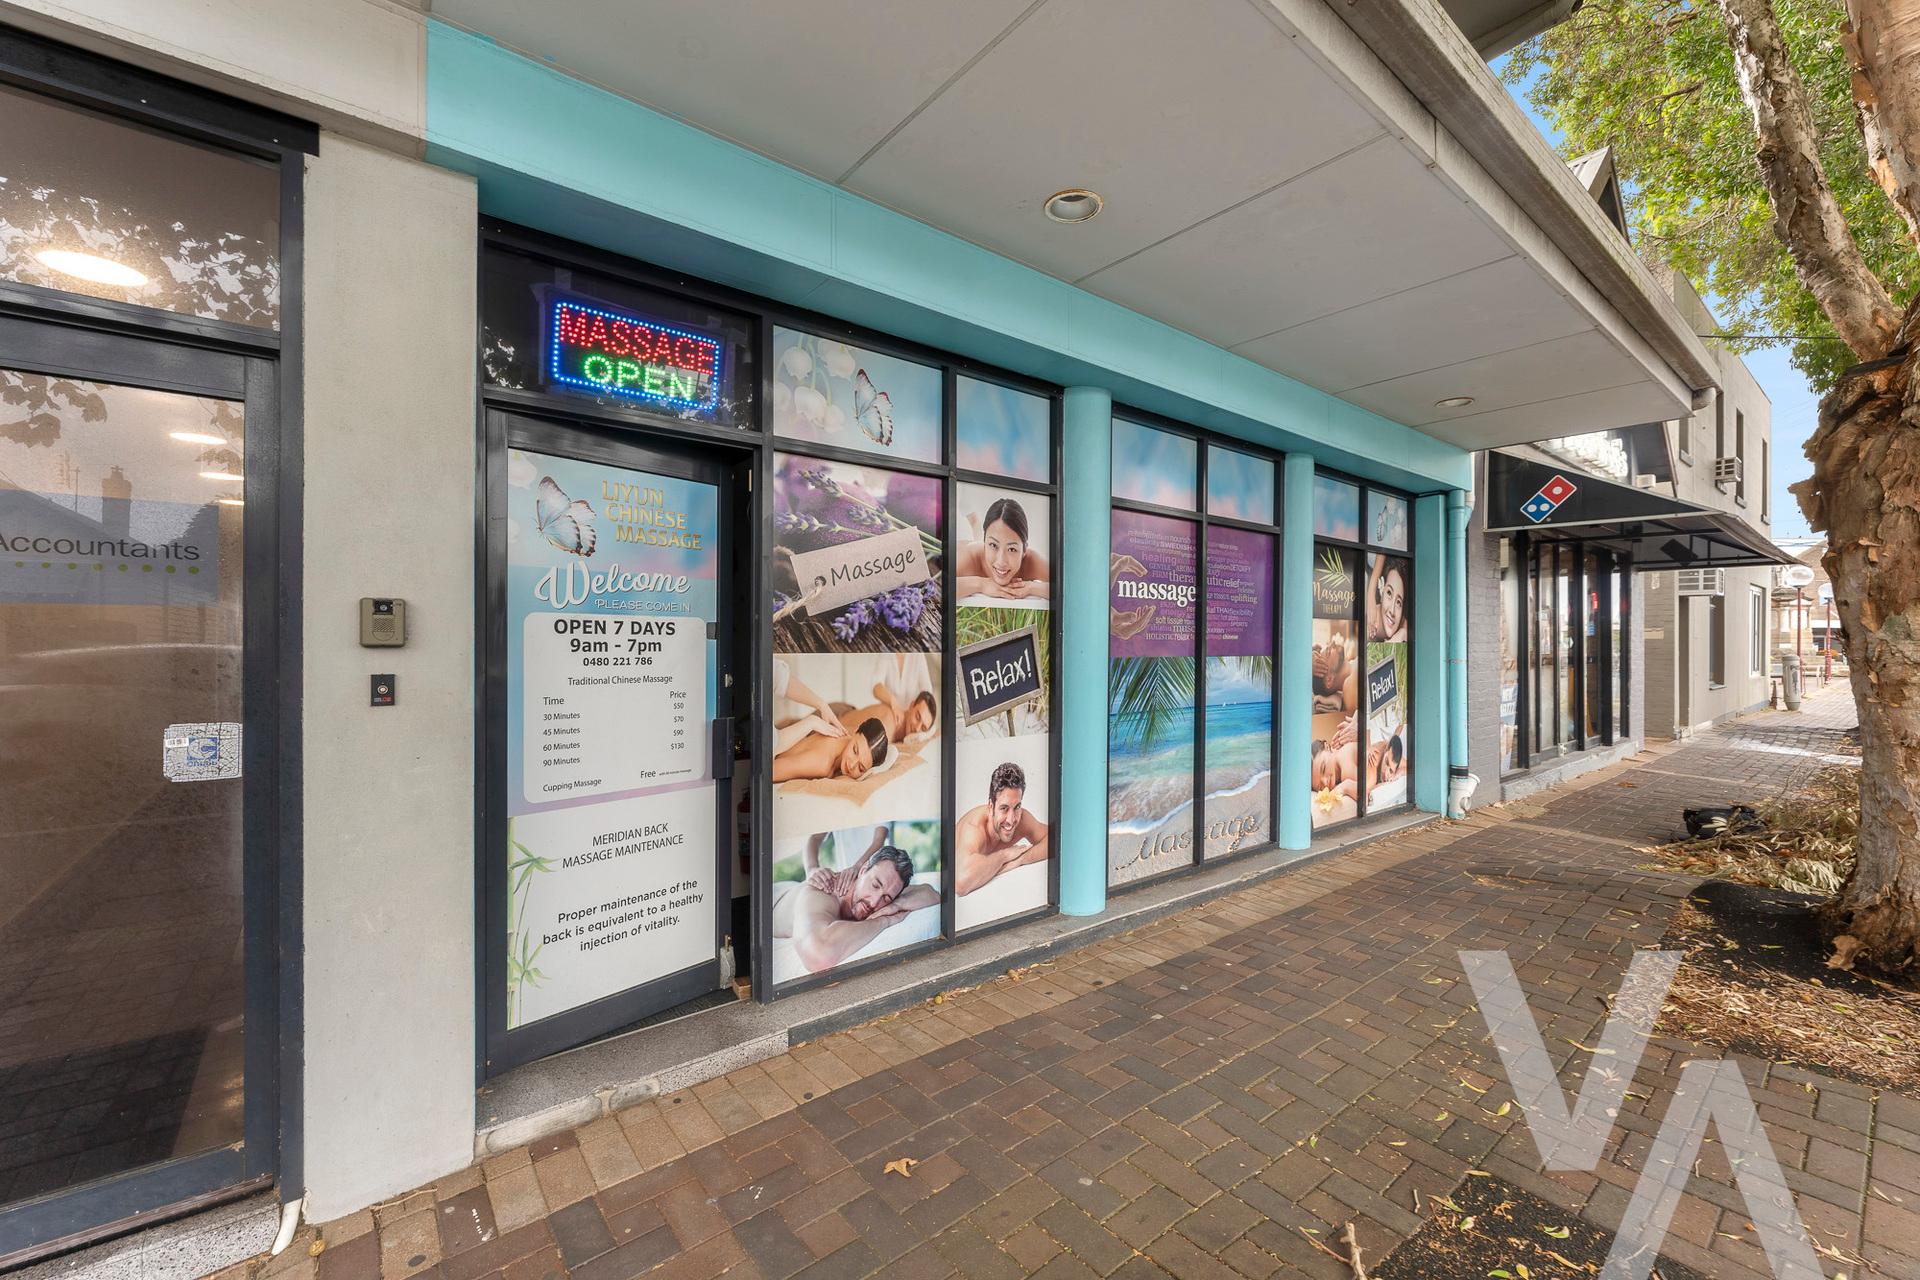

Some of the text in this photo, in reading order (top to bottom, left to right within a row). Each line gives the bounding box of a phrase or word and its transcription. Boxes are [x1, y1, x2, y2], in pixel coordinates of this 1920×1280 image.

[560, 306, 716, 375] MASSAGE
[584, 354, 693, 402] OPEN
[602, 480, 664, 507] LIYUN
[606, 503, 688, 530] CHINESE
[616, 525, 704, 551] MASSAGE
[1142, 551, 1177, 566] healing
[830, 548, 916, 587] Massage
[534, 560, 691, 610] Welcome
[1117, 580, 1196, 608] massage
[595, 599, 692, 612] PLEASE COME IN
[553, 619, 676, 635] OPEN 7 DAYS
[570, 638, 609, 652] 9am
[627, 639, 662, 655] 7pm
[583, 656, 653, 666] 0480 221 786
[568, 674, 673, 686] Traditional Chinese Massage
[970, 648, 1032, 700] Relax!
[1371, 669, 1395, 703] Relax!
[543, 697, 565, 706] Time
[669, 690, 687, 699] Price
[673, 702, 684, 710] $50
[543, 711, 581, 721] 30 Minutes
[673, 715, 684, 723] $70
[543, 726, 581, 736] 45 Minutes
[673, 728, 684, 737] $90
[543, 741, 581, 752] 60 Minutes
[670, 742, 685, 750] $130
[543, 756, 581, 767] 90 Minutes
[640, 770, 656, 779] Free
[543, 778, 602, 792] Cupping Massage
[592, 822, 669, 847] MERIDIAN BACK
[562, 834, 684, 869] MASSAGE MAINTENANCE
[558, 880, 698, 924] Proper maintenance of the
[543, 893, 704, 945] back is equivalent to a healthy
[580, 915, 680, 952] injection of vitality.
